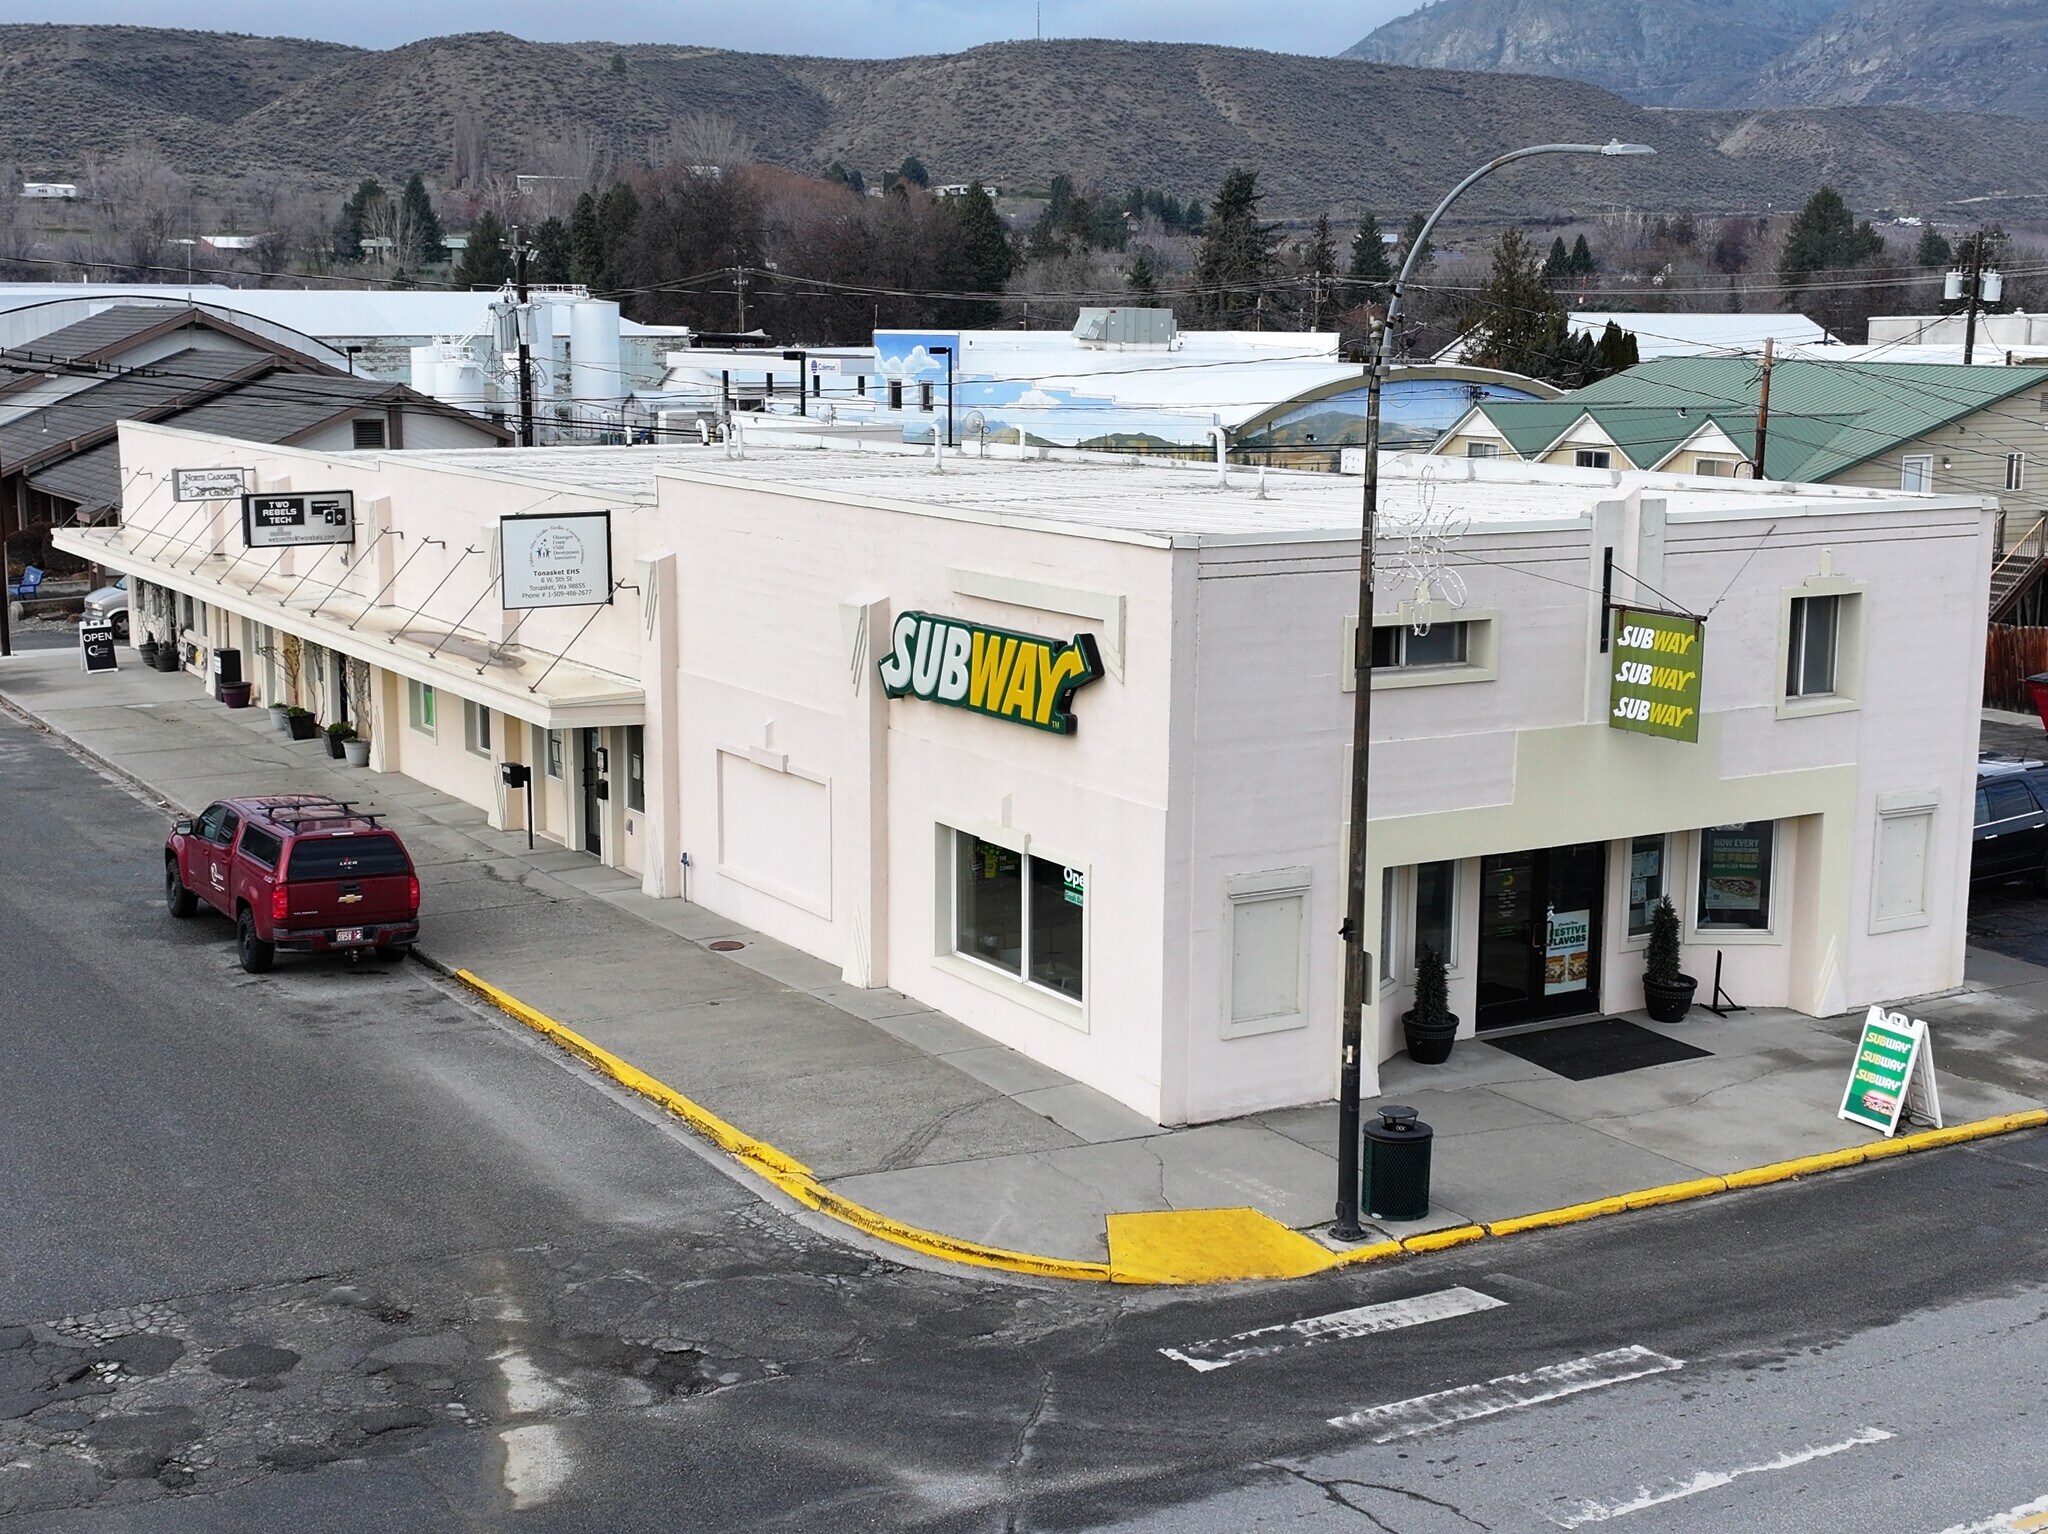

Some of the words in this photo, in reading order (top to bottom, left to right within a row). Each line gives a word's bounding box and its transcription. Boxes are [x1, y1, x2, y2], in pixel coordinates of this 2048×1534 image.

[184, 473, 206, 482] North
[207, 472, 238, 481] Cascades
[189, 489, 206, 498] Law
[268, 501, 290, 509] TWO
[262, 508, 297, 517] REBELS
[269, 516, 292, 525] TECH
[533, 569, 565, 577] Tonasket
[521, 591, 540, 599] Phone
[83, 631, 113, 643] OPEN
[1617, 625, 1695, 654] SUBWAY
[880, 616, 1085, 724] SUBWAY
[1615, 661, 1696, 692] SUBWAY
[1613, 696, 1694, 727] SUBWAY
[1734, 838, 1760, 847] EVERY
[1554, 925, 1587, 937] ESTIVE
[1553, 934, 1587, 946] LAVORS
[1866, 1032, 1912, 1054] SUBWAY
[1861, 1050, 1907, 1073] SUBWAY
[1856, 1069, 1903, 1091] SUBWAY
